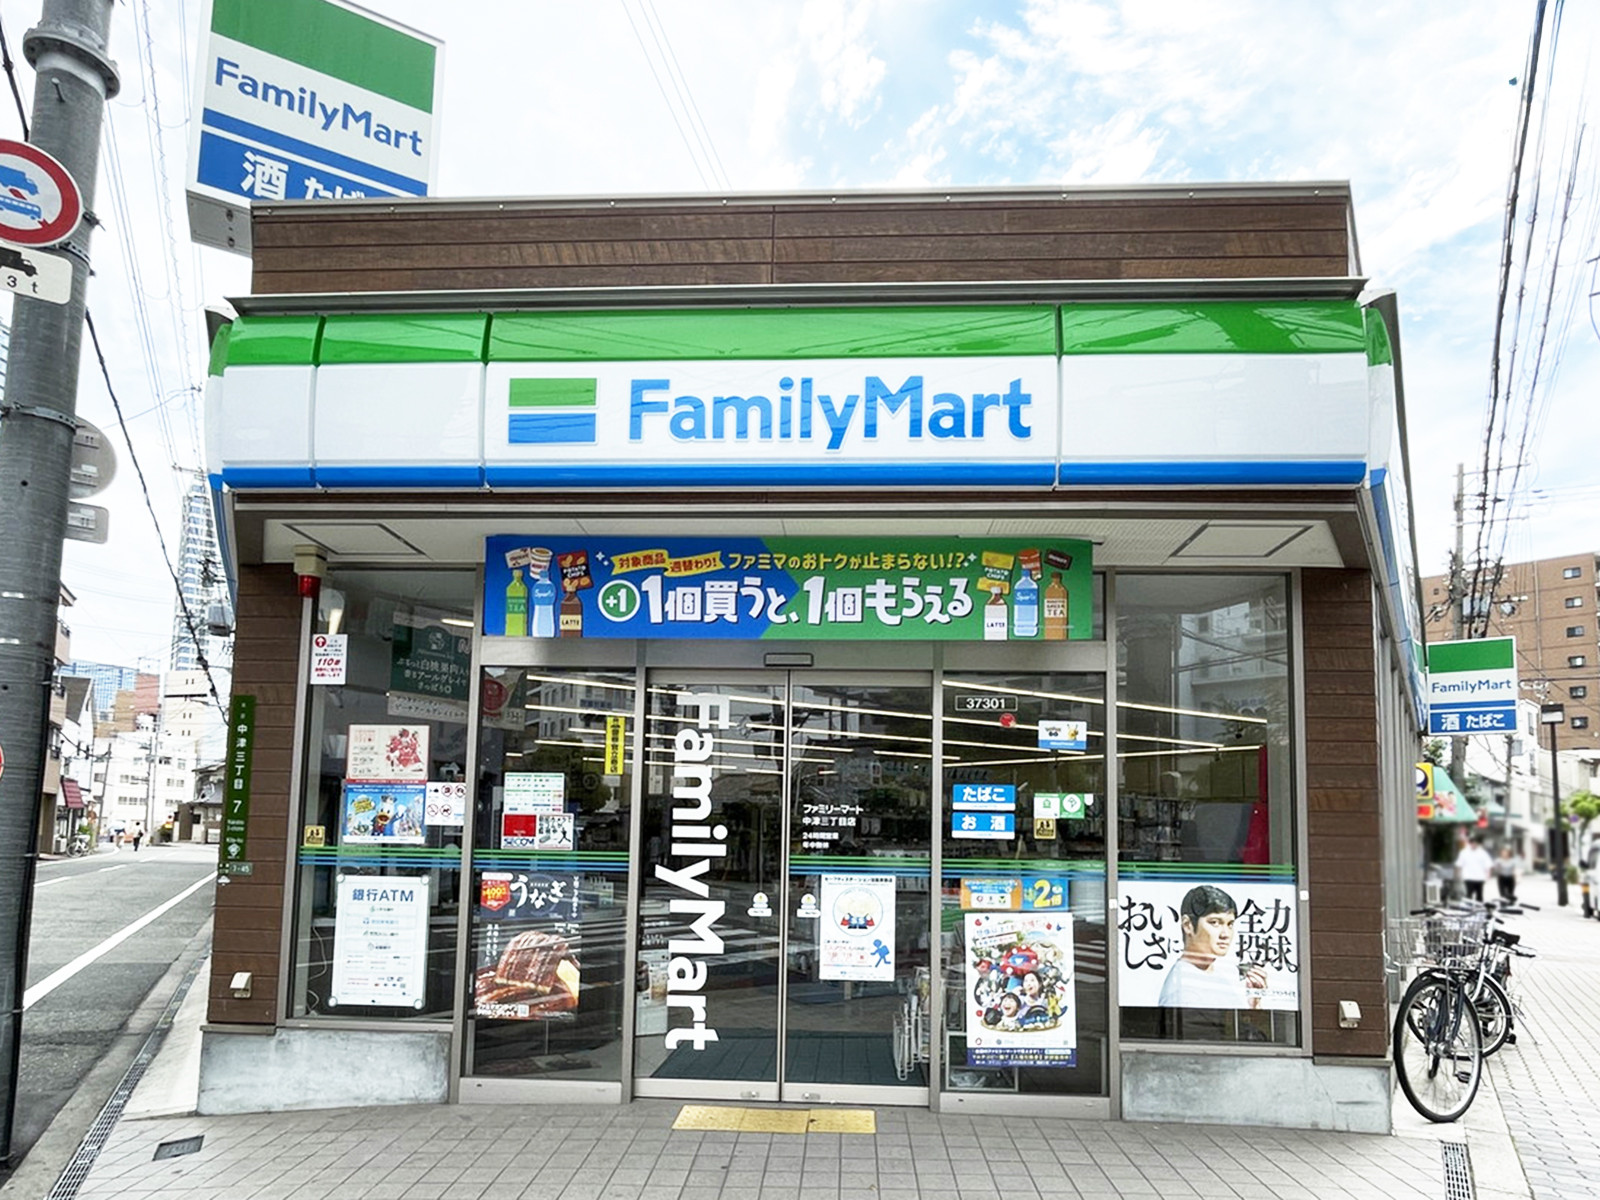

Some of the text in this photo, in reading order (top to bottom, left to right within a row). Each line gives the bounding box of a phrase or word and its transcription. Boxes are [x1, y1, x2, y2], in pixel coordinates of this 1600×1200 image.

[215, 57, 422, 156] FamilyMart
[240, 151, 289, 200] 酒
[7, 275, 38, 294] 3 t
[628, 375, 1032, 451] FamilyMart
[619, 551, 717, 573] 対象商品 週替わり!
[508, 603, 526, 613] TEA
[1047, 609, 1065, 617] TEA
[1432, 679, 1512, 693] FamilyMart
[966, 698, 1005, 709] 37301
[1441, 713, 1505, 731] 酒 たばこ
[962, 786, 1006, 802] たばこ
[232, 799, 242, 814] 7
[803, 804, 864, 815] ファミリーマート
[655, 695, 730, 1050] FamilyMart
[352, 888, 414, 902] 銀行ATM
[510, 874, 567, 910] うなぎ
